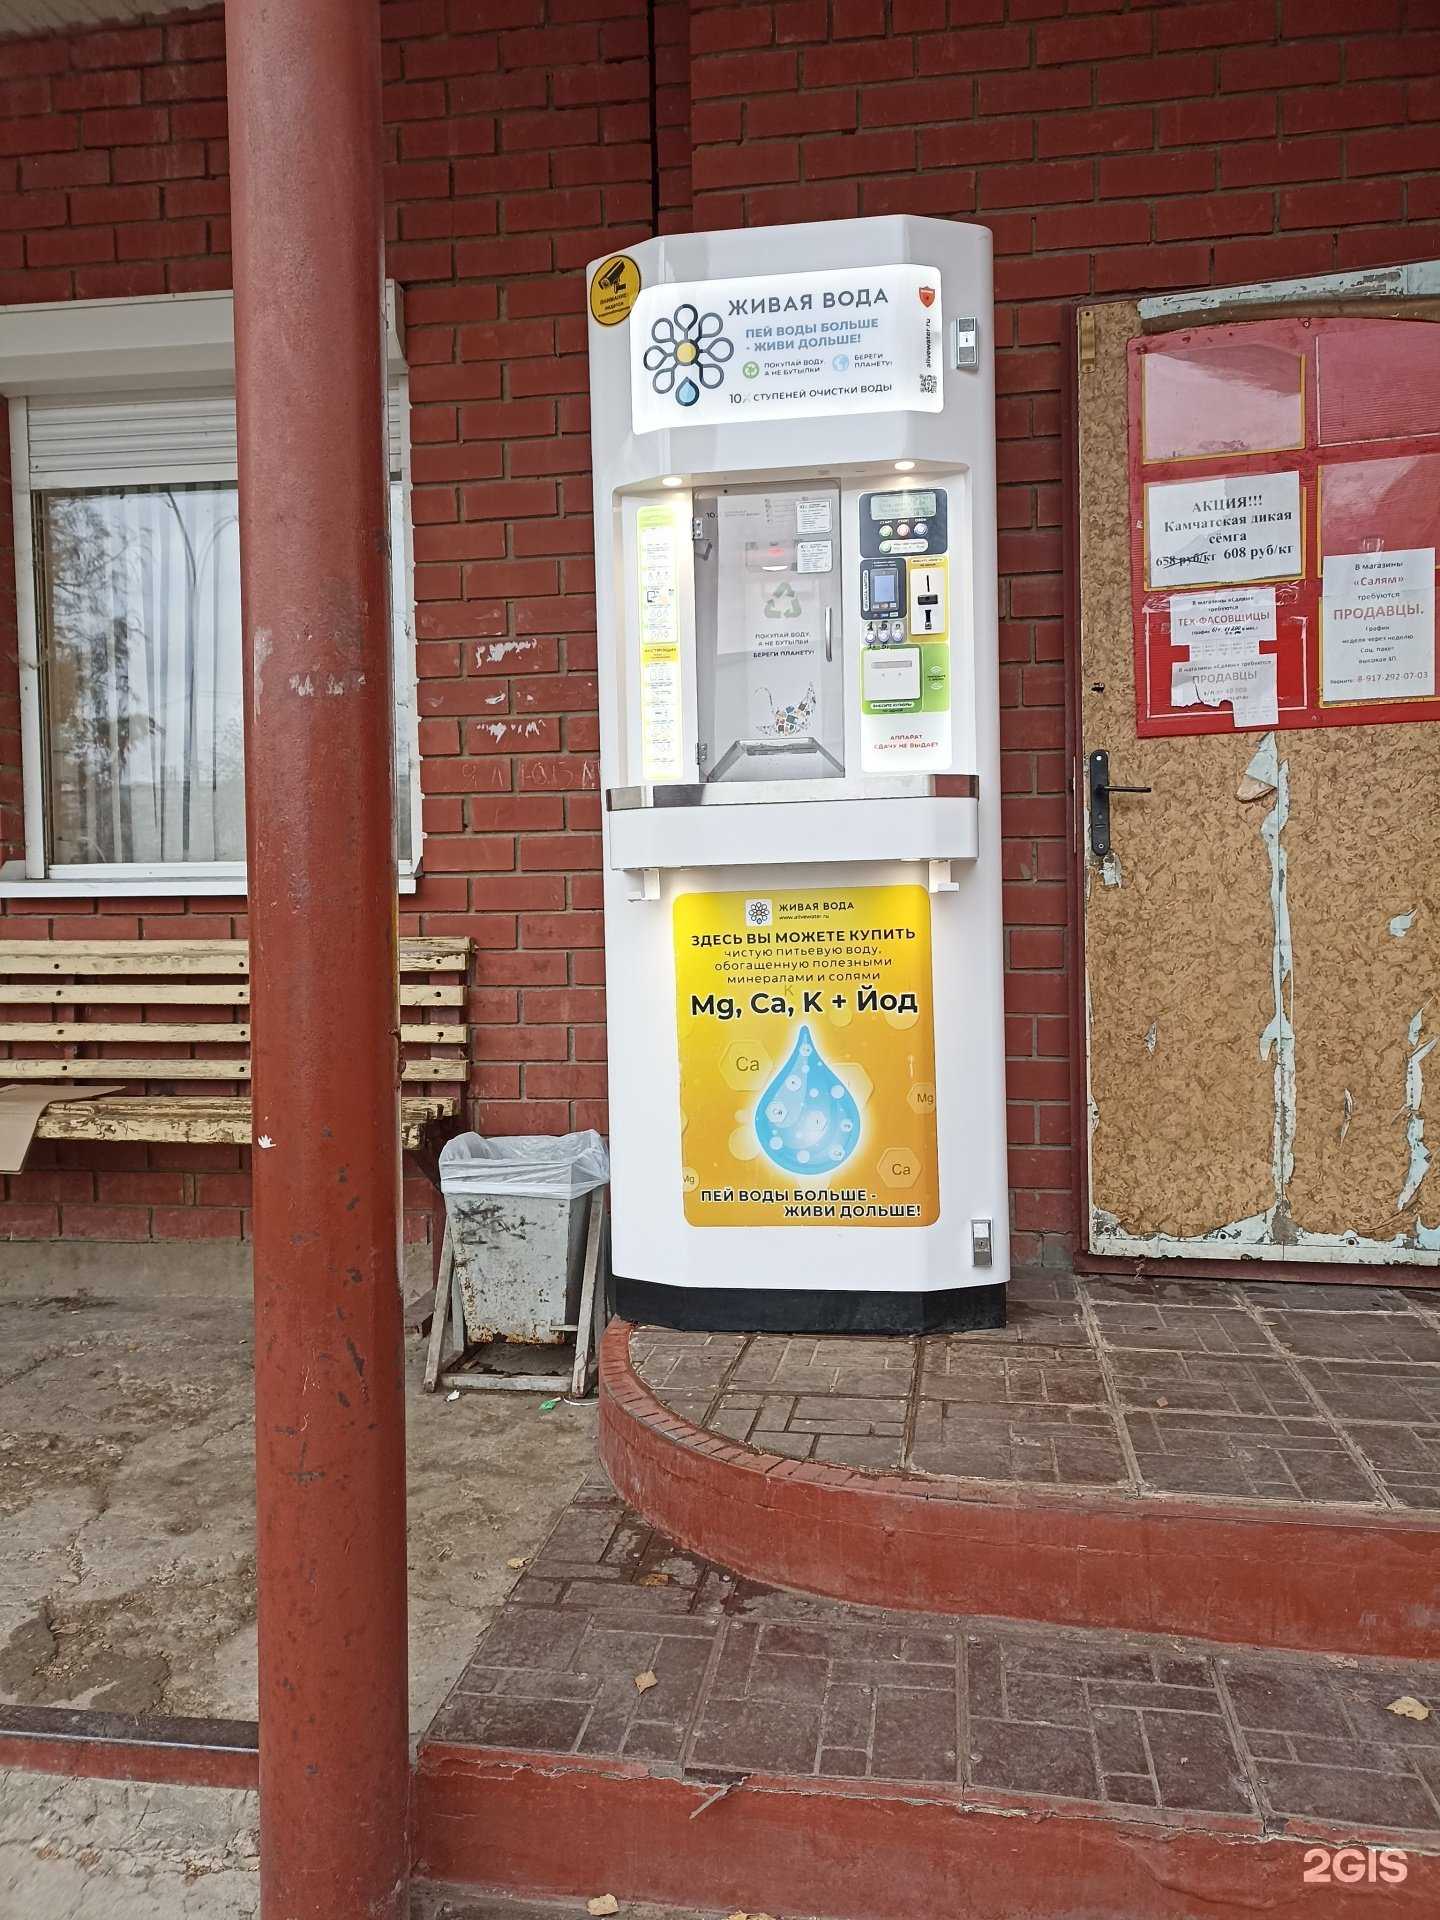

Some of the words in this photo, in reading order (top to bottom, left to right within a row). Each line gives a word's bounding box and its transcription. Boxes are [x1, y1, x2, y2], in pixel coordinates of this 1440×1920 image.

[728, 294, 812, 316] ЖИВАЯ
[823, 288, 888, 309] ВОДА
[745, 326, 773, 339] ПЕЙ
[776, 323, 817, 337] ВОДЫ
[821, 318, 880, 332] БОЛЬШЕ
[754, 339, 795, 352] ЖИВИ
[798, 333, 861, 350] ДОЛЬШЕ!
[764, 359, 802, 369] ПОКУПАЙ
[803, 358, 824, 367] ВОДУ
[854, 353, 884, 361] БЕРЕГИ
[783, 366, 821, 376] БУТЫЛКИ
[753, 389, 807, 402] СТУПЕНЕЙ
[809, 386, 858, 398] ОЧИСТКИ
[860, 383, 893, 394] ВОДЫ
[1192, 495, 1263, 513] АКЦИЯ!!!
[1164, 516, 1247, 533] Камчатская
[1250, 511, 1292, 524] дикая
[1208, 532, 1247, 544] сёмга
[1223, 546, 1246, 560] 608
[1250, 543, 1294, 560] руб/кг
[1355, 563, 1361, 571] В
[1362, 562, 1404, 570] магазины
[1354, 576, 1405, 587] «Салям»
[1358, 591, 1401, 601] требуются
[1333, 603, 1425, 620] ПРОДАВЦЫ.
[1192, 670, 1257, 684] ПРОДАВЦЫ
[778, 902, 819, 912] ЖИВАЯ
[823, 901, 855, 911] ВОДА
[691, 934, 743, 948] ЗДЕСЬ
[746, 933, 771, 945] ВЫ
[776, 930, 845, 944] МОЖЕТЕ
[849, 928, 916, 942] КУПИТЬ
[724, 948, 773, 959] чистую
[776, 946, 843, 958] питьевую
[714, 960, 810, 972] обогащенную
[812, 957, 892, 969] полезными
[727, 974, 814, 986] минералами
[817, 974, 825, 982] и
[829, 972, 881, 982] солями
[691, 994, 742, 1020] Mg,
[750, 993, 794, 1017] Ca,
[832, 994, 847, 1009] +
[857, 985, 918, 1013] Йод
[735, 1057, 760, 1072] Ca
[917, 1093, 934, 1105] Mg
[891, 1163, 911, 1176] Ca
[701, 1189, 734, 1202] ПЕЙ
[739, 1190, 789, 1203] ВОДЫ
[793, 1190, 867, 1202] БОЛЬШЕ
[784, 1205, 835, 1217] ЖИВИ
[839, 1205, 921, 1219] ДОЛЬШЕ!
